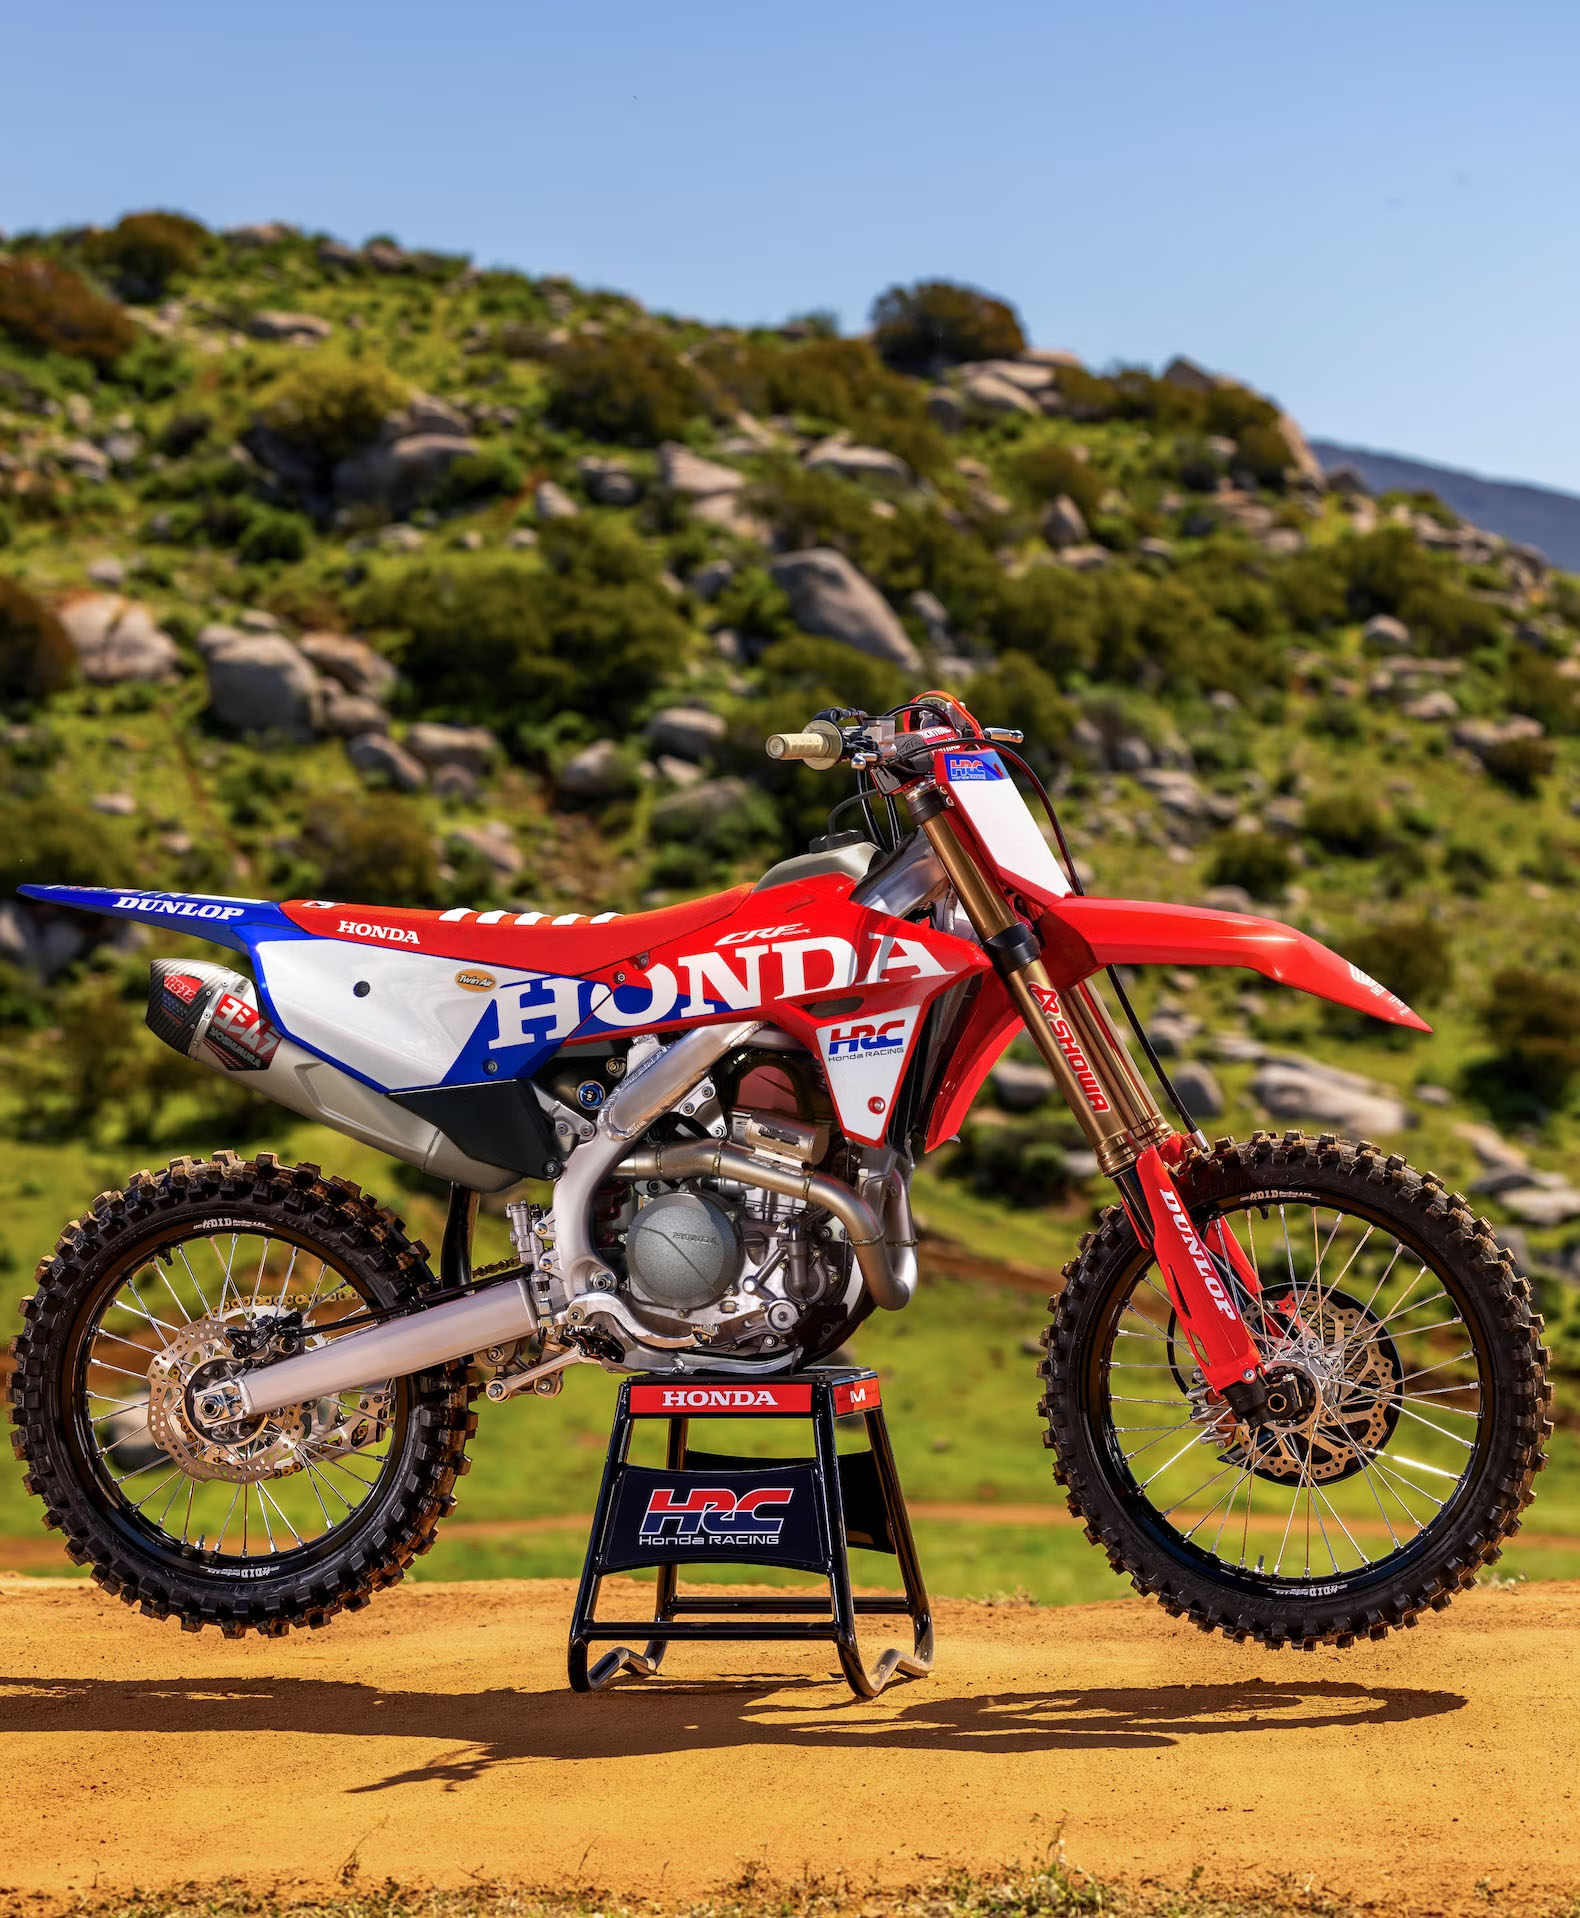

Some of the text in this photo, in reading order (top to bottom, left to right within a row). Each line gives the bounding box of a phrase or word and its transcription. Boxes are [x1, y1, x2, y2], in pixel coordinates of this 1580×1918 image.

[950, 760, 986, 776] HRC
[112, 896, 245, 921] DUNLOP
[336, 920, 421, 945] HONDA
[714, 922, 804, 946] CRF
[457, 974, 495, 988] Twin Air
[488, 933, 956, 1049] HONDA
[208, 1025, 262, 1069] YOSHIMURA
[828, 1019, 906, 1055] HRC
[828, 1047, 905, 1063] Honda RACING
[1048, 1018, 1111, 1113] SHOWA
[1160, 1188, 1237, 1321] DUNLOP
[662, 1390, 779, 1407] HONDA
[850, 1388, 866, 1403] M
[639, 1488, 795, 1535] HRC
[639, 1534, 780, 1546] Honda RACING
